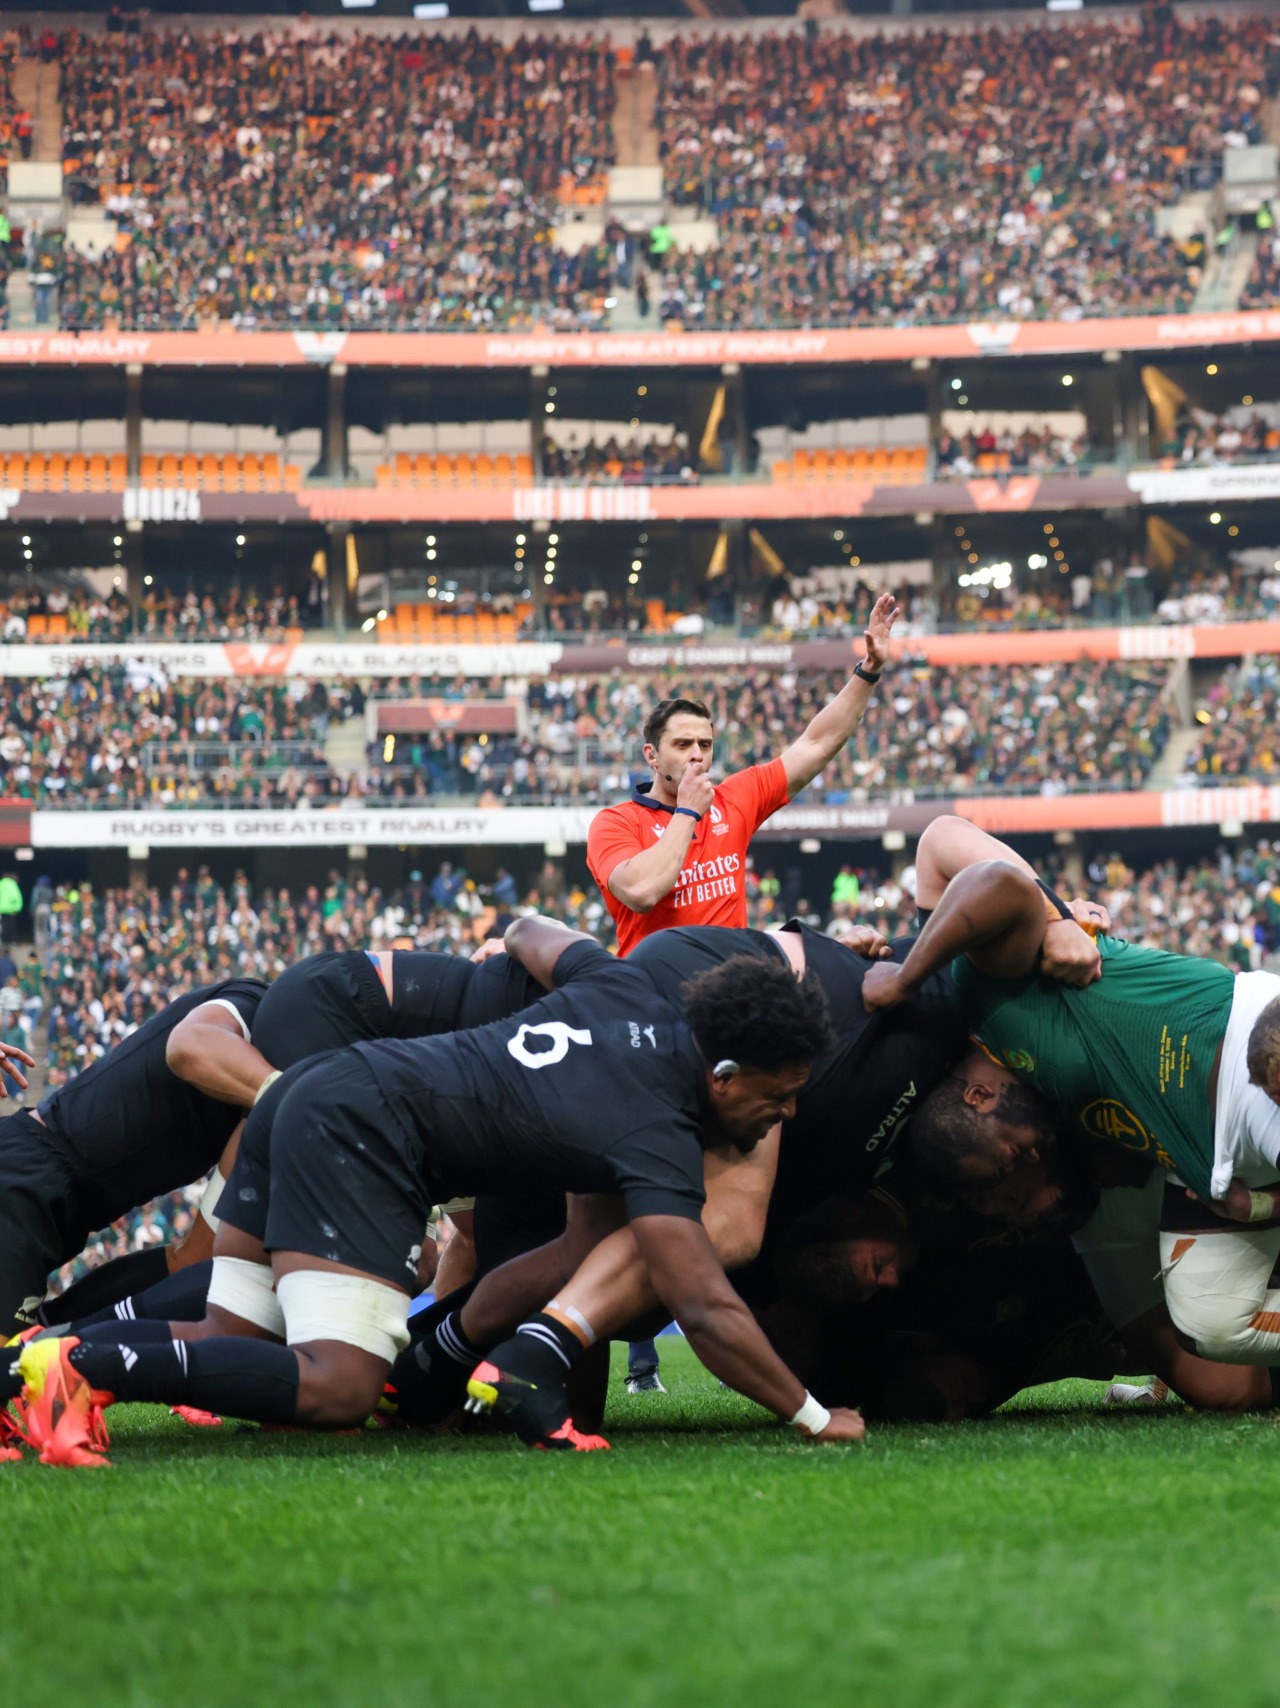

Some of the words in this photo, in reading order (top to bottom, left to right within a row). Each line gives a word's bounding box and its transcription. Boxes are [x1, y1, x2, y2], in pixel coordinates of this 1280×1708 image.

[48, 338, 151, 355] RIVALRY
[597, 338, 723, 357] GREATEST
[725, 336, 827, 355] RIVALRY
[312, 654, 356, 669] ALL
[364, 654, 459, 669] BLACKS
[111, 819, 226, 838] RUGBY'S
[236, 818, 368, 837] GREATEST
[380, 817, 489, 836] RIVALRY
[674, 852, 740, 888] mirates
[674, 887, 693, 909] FLY
[696, 875, 736, 903] BETTER
[507, 1020, 593, 1070] 6
[865, 1079, 917, 1152] ALTRAD
